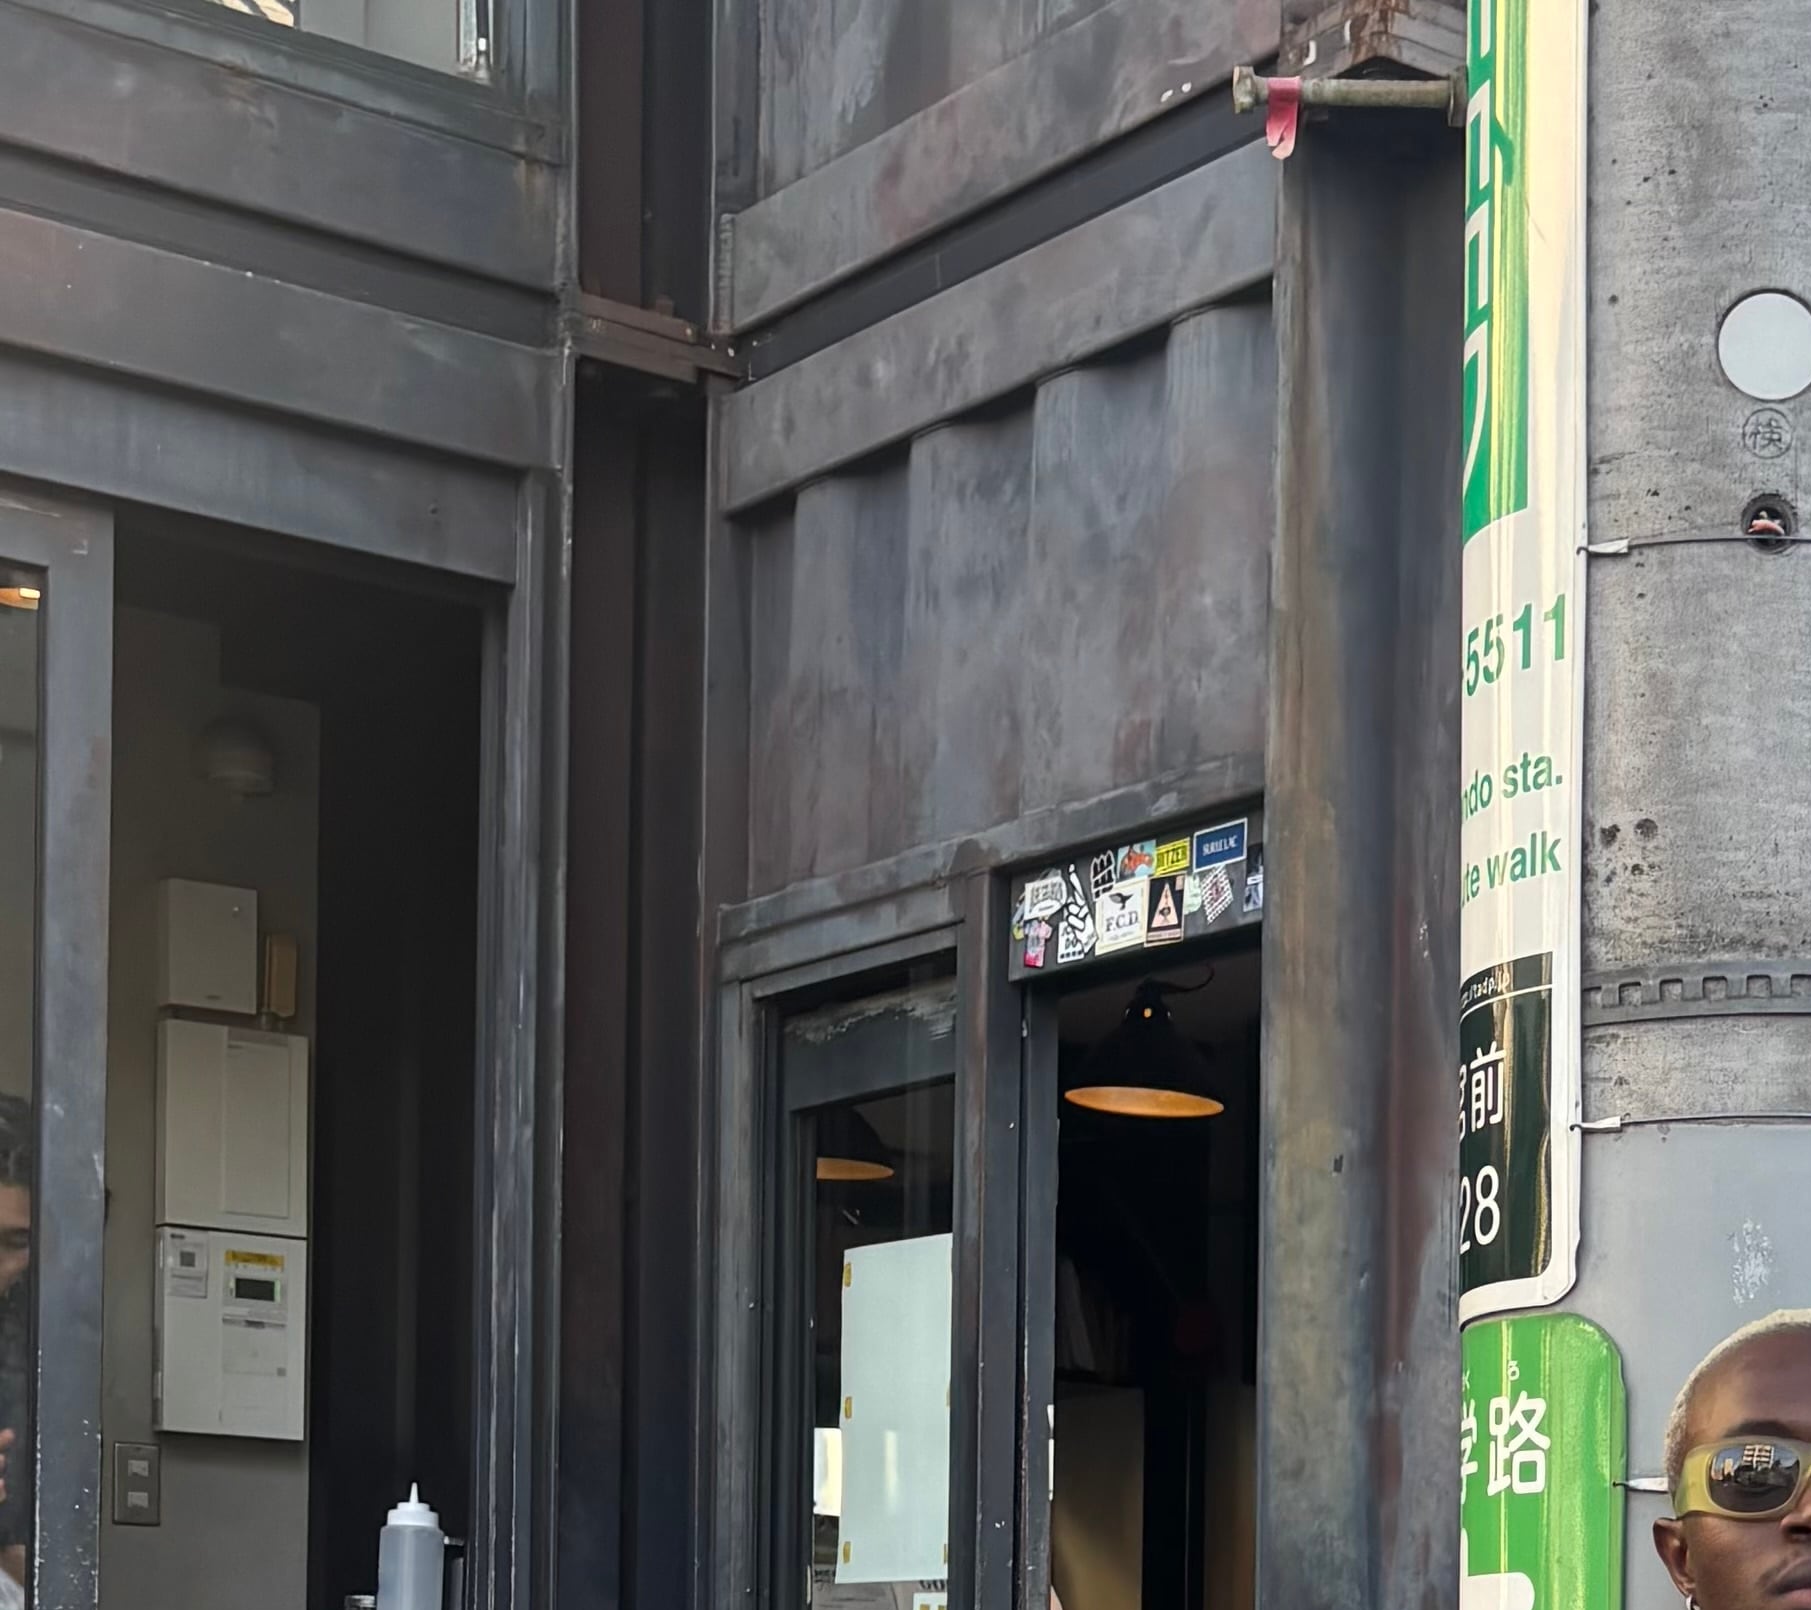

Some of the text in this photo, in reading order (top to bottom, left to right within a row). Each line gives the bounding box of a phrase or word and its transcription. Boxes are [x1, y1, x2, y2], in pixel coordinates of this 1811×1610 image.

[1466, 593, 1566, 697] 5511
[1502, 752, 1563, 799] sta.
[1487, 830, 1562, 890] walk
